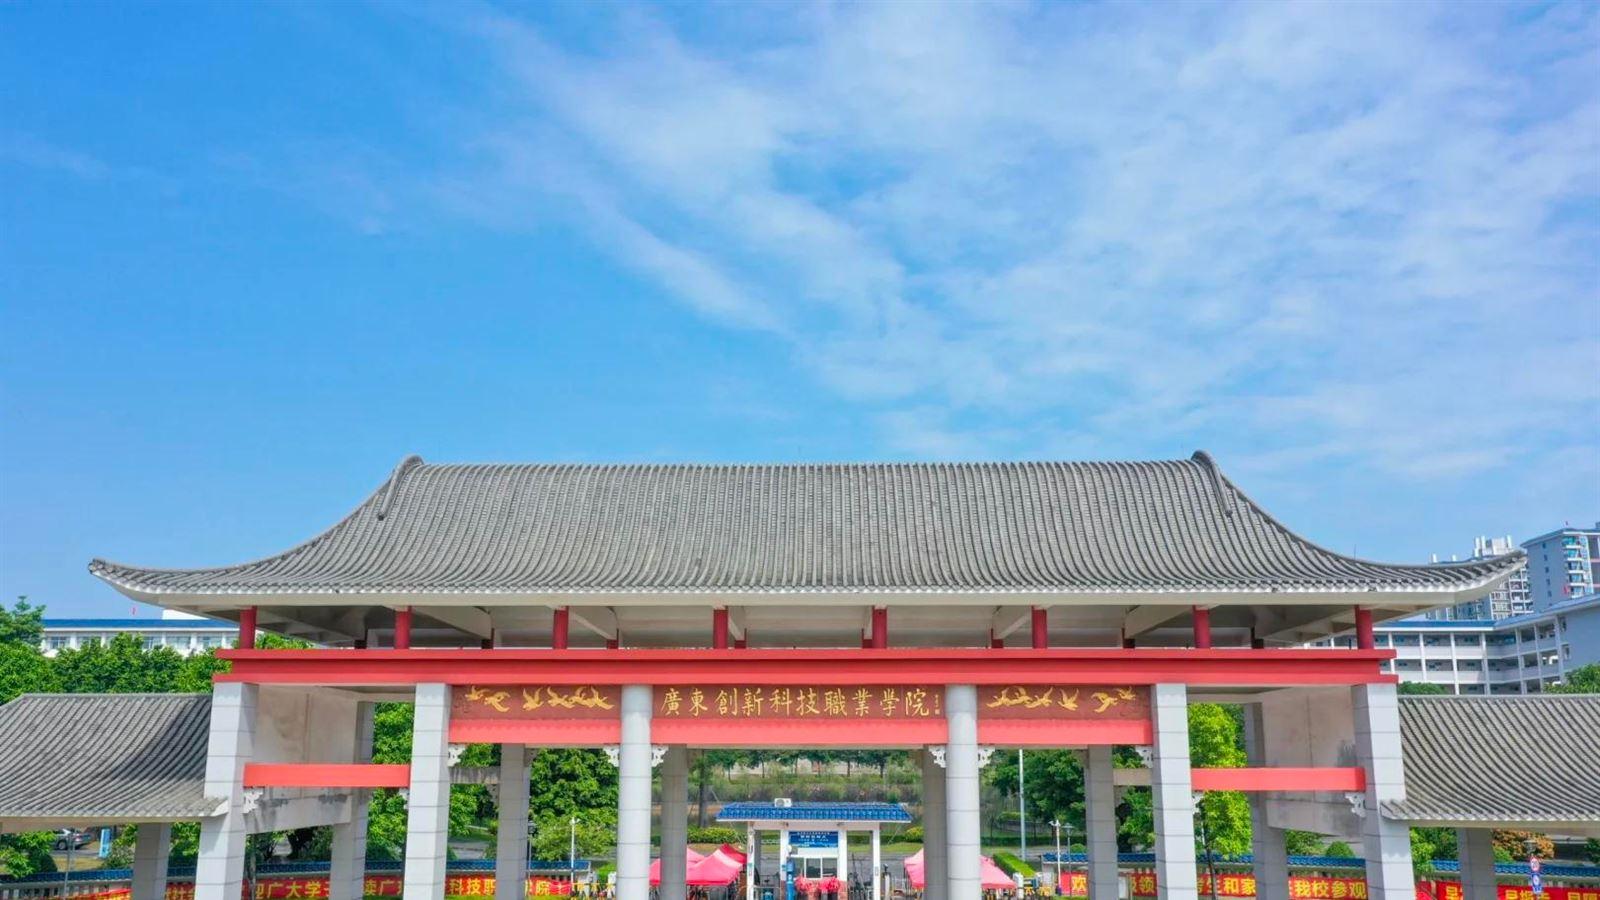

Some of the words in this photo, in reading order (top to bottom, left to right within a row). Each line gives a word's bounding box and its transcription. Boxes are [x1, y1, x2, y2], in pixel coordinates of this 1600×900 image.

[661, 687, 930, 717] 廣東創新科技職業學院
[1289, 880, 1367, 899] 我校参观
